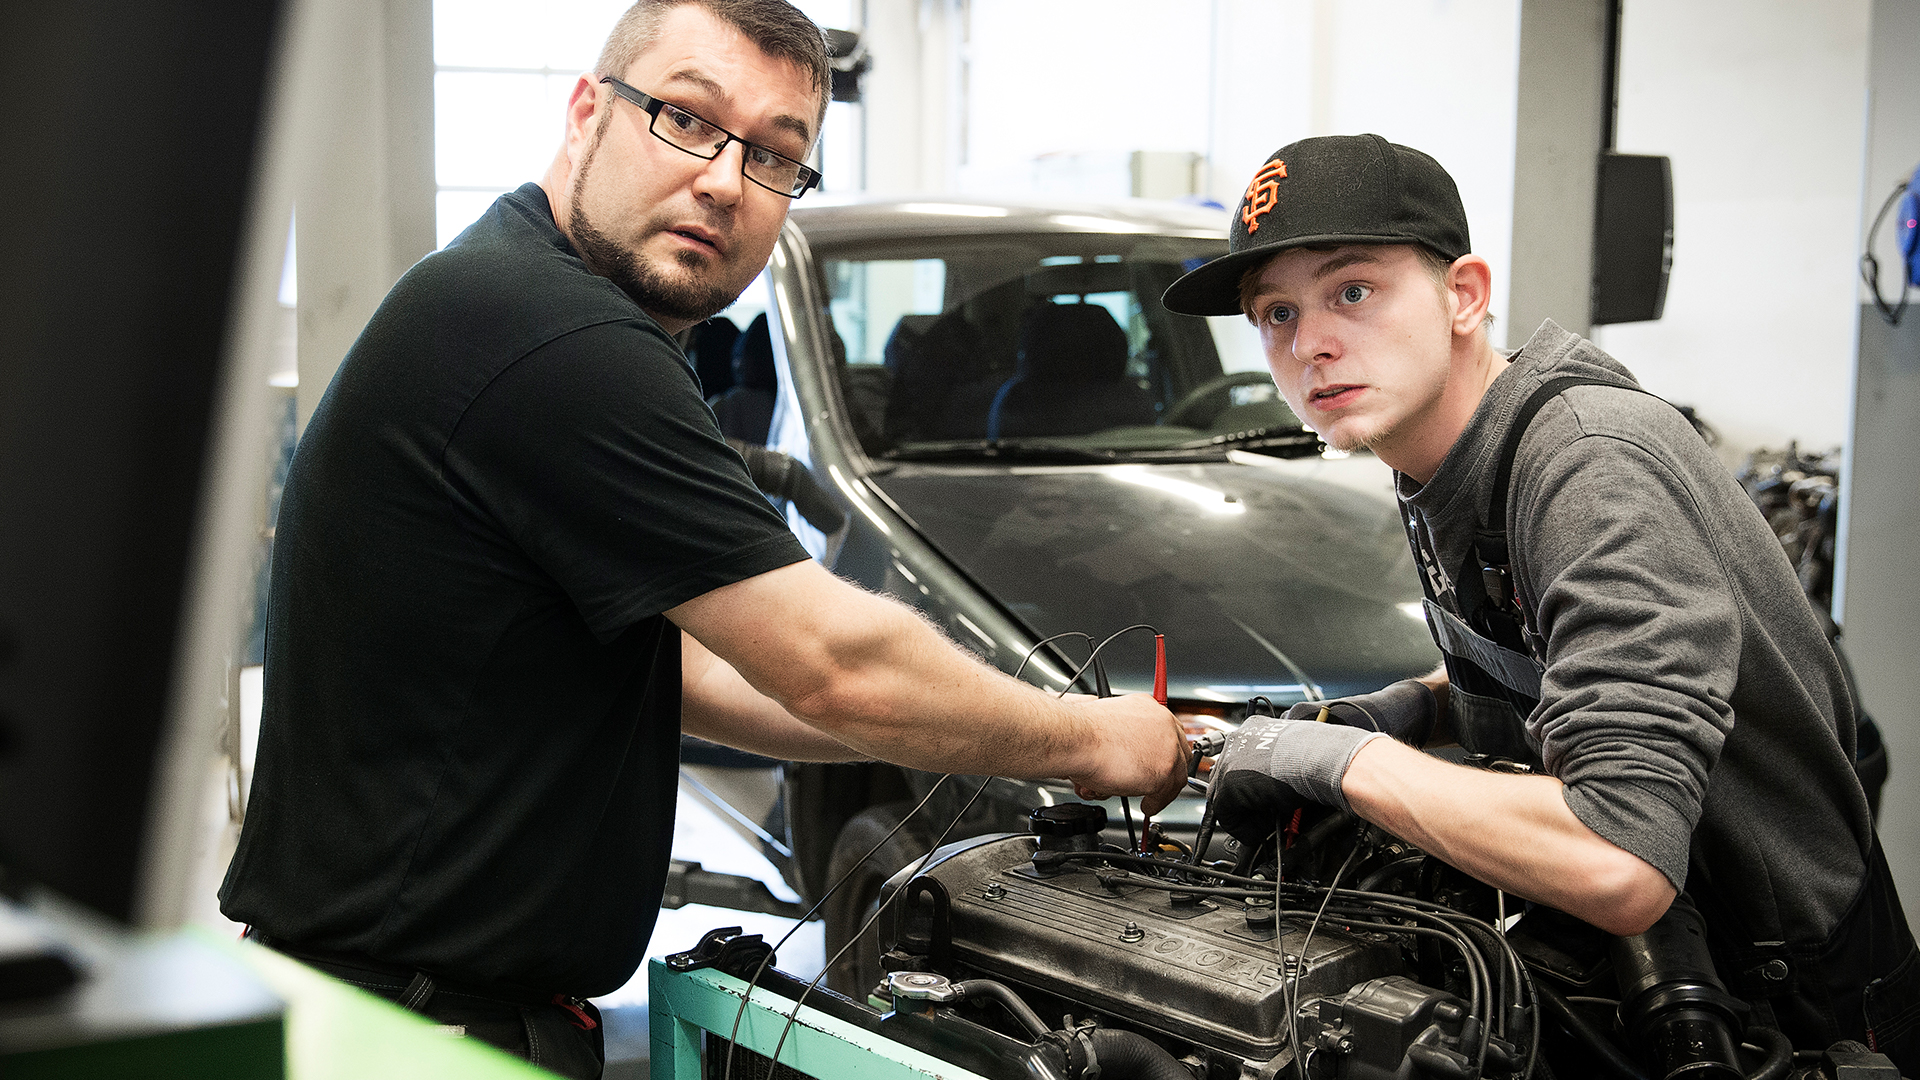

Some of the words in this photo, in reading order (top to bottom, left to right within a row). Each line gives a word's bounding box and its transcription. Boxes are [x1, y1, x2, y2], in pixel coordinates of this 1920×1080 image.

[1242, 158, 1288, 235] SF
[1255, 720, 1294, 750] DIN
[1137, 932, 1265, 981] TOYOTA
